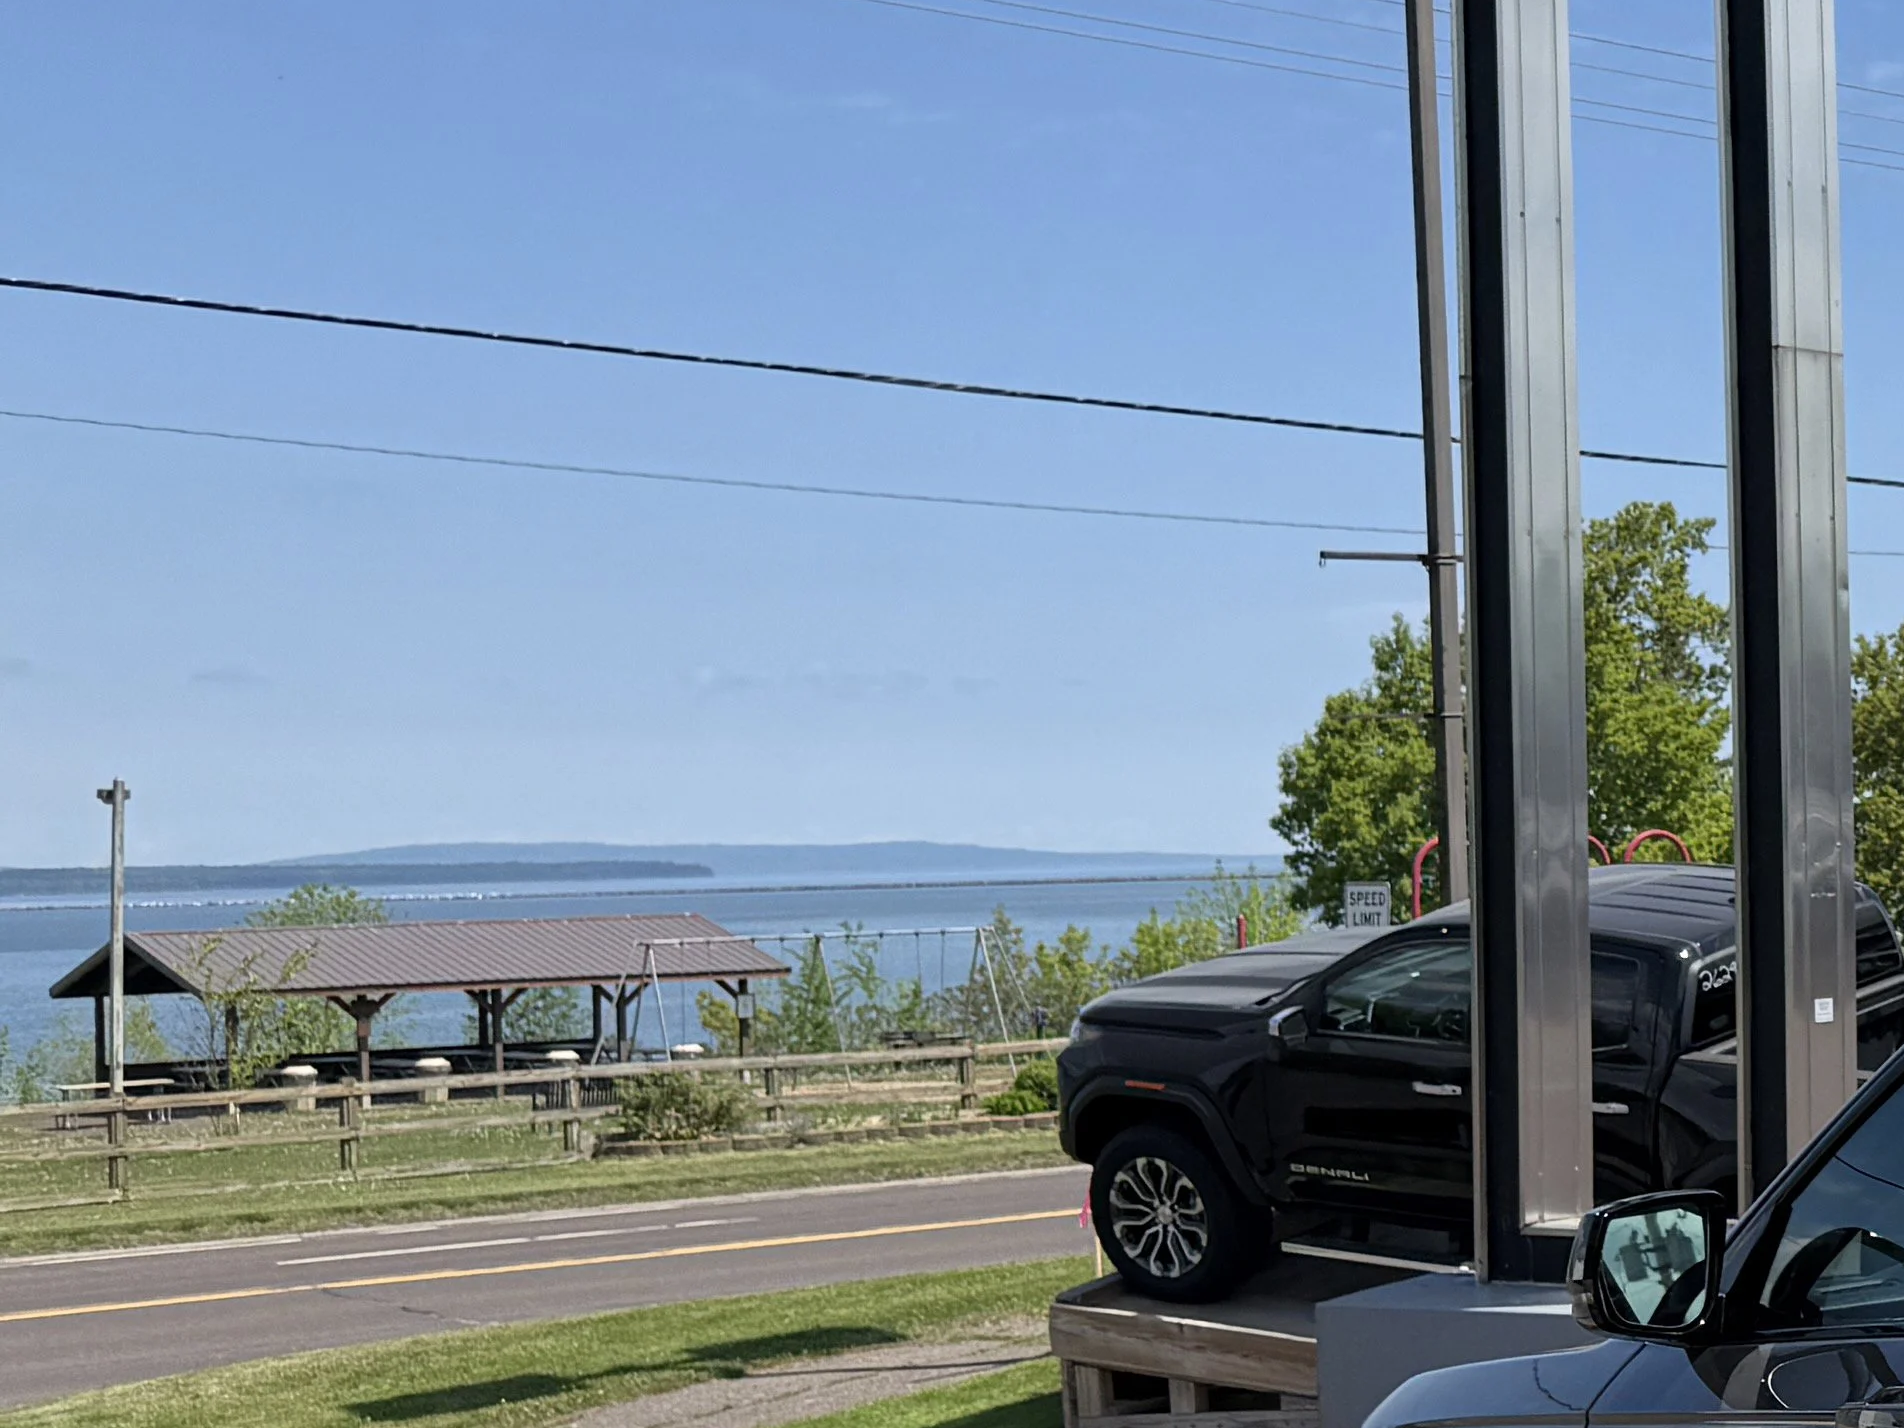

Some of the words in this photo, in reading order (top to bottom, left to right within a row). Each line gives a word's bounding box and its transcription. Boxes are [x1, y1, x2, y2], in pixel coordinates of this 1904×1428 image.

[1349, 891, 1386, 907] SPEED
[1353, 912, 1382, 927] LIMIT
[1290, 1163, 1369, 1181] DENALI
